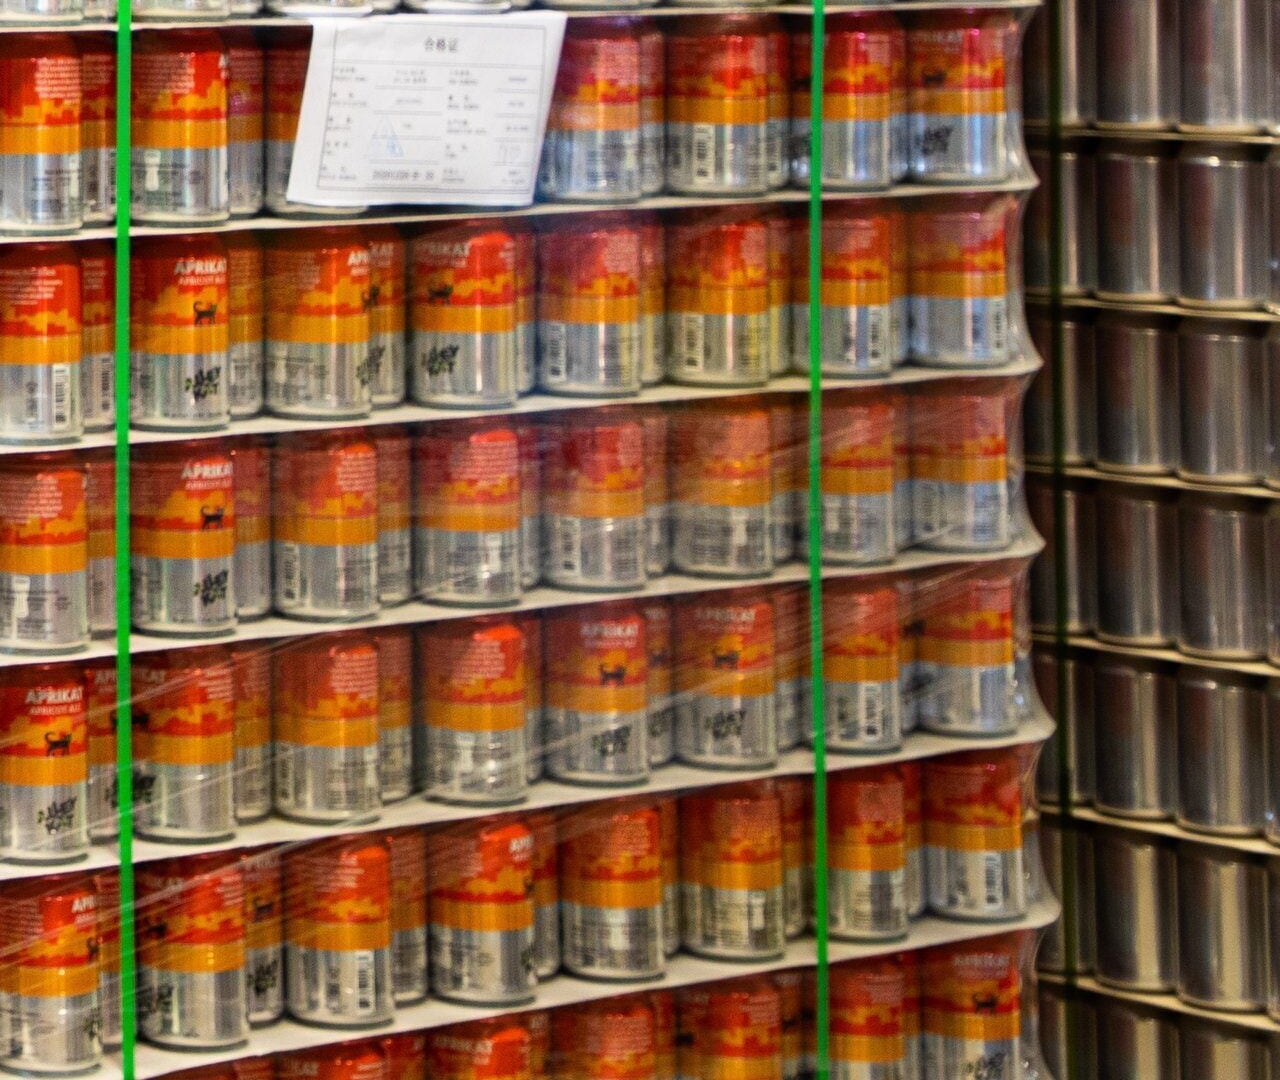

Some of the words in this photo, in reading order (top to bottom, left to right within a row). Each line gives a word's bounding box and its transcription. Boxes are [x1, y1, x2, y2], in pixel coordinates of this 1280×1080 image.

[424, 36, 460, 53] 合格证
[25, 685, 84, 704] APRIKAT
